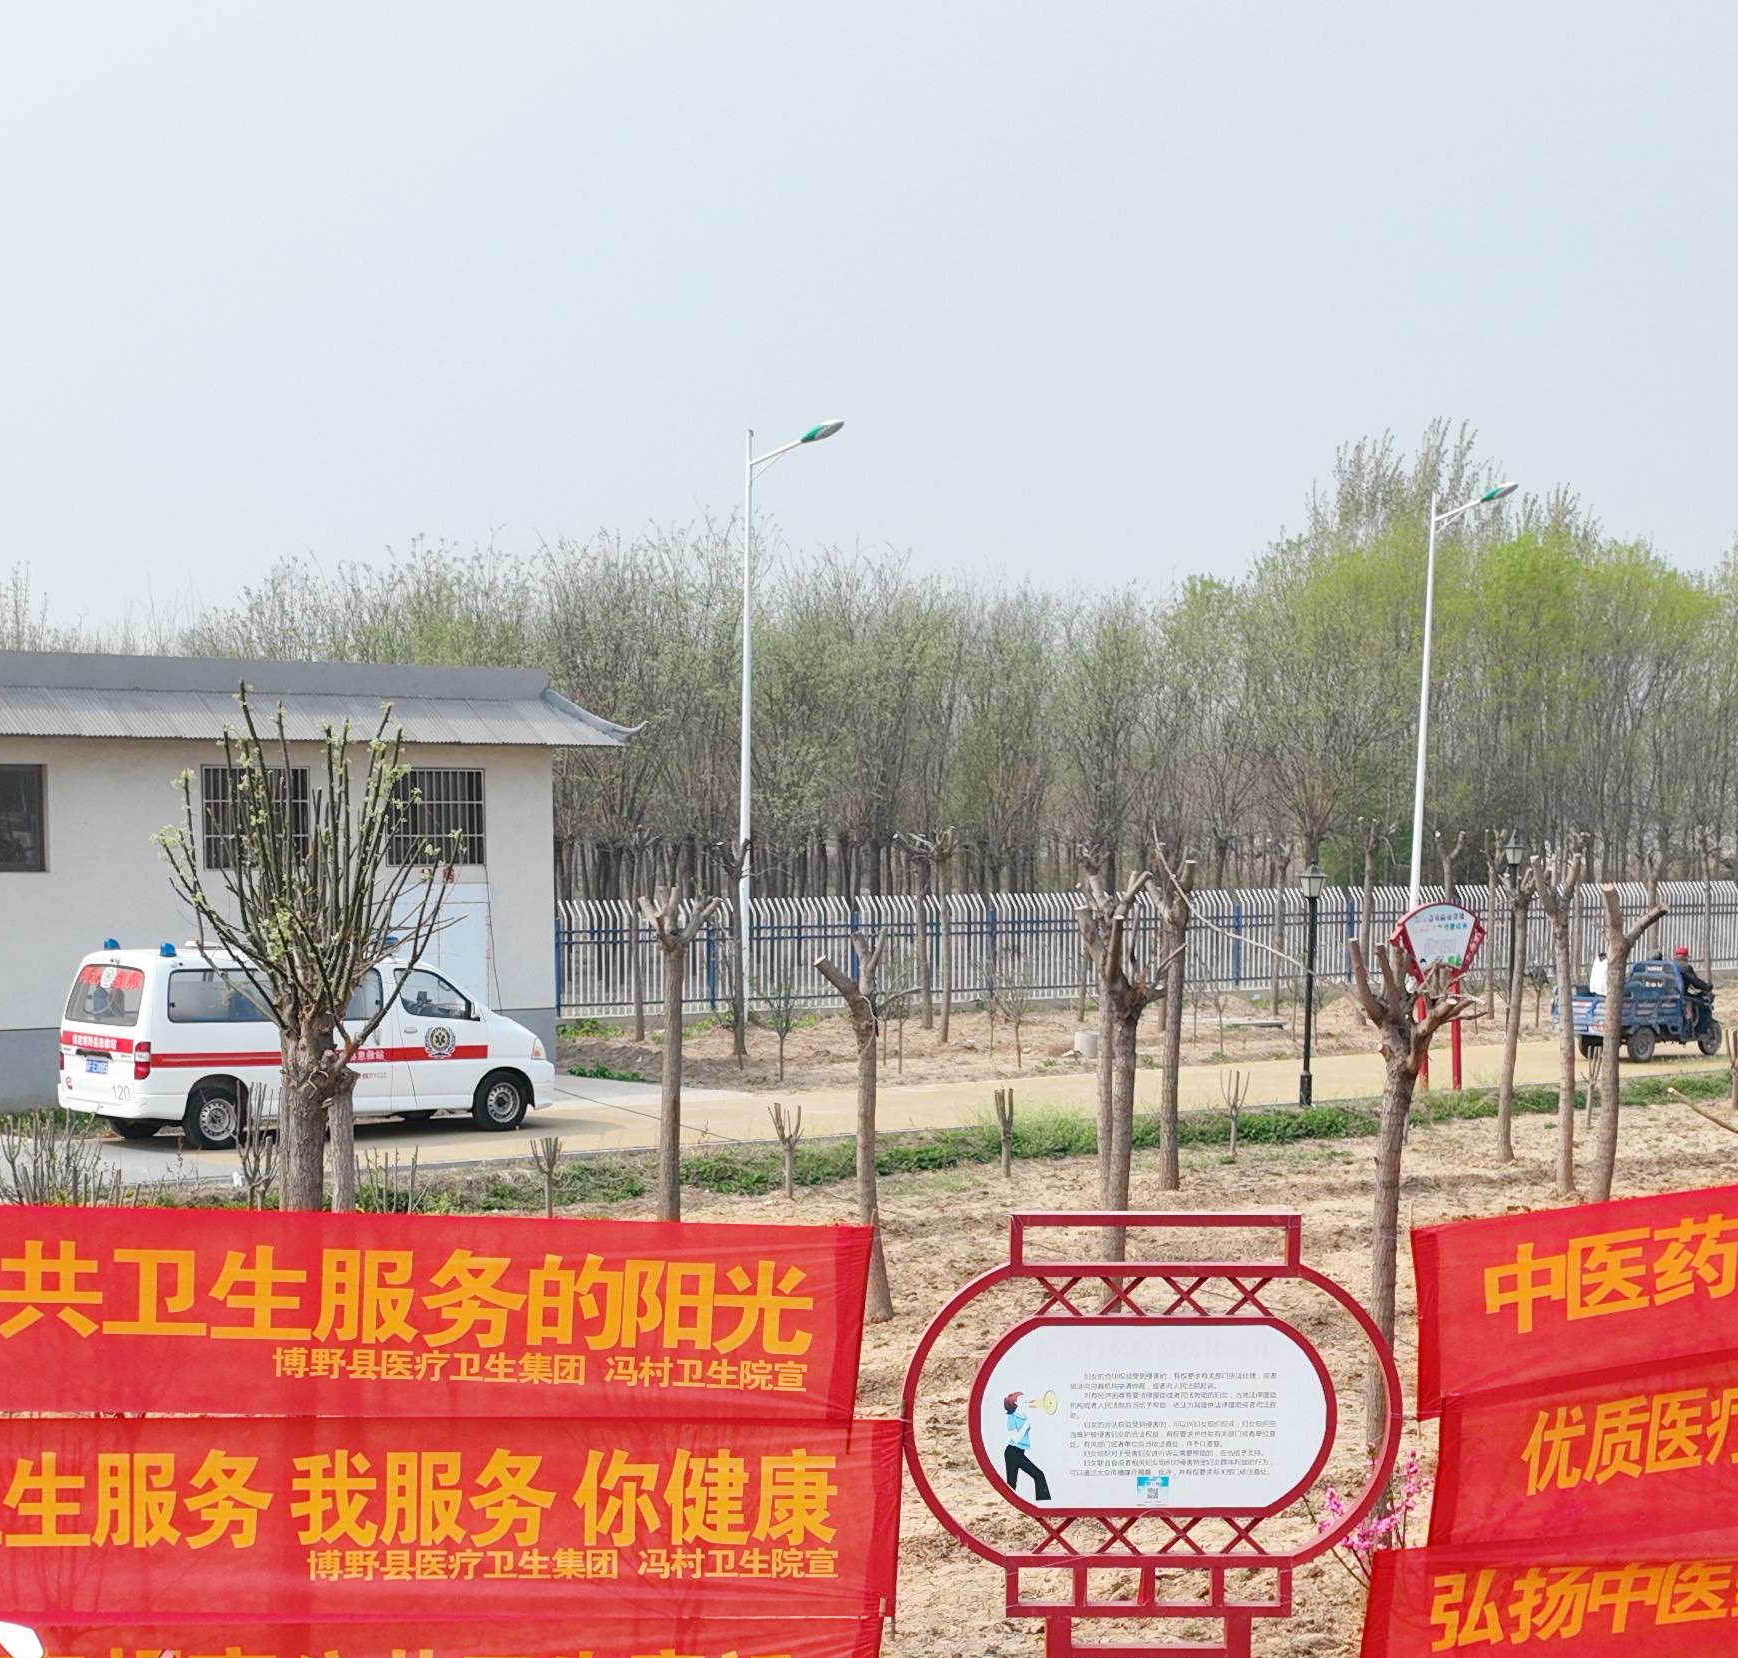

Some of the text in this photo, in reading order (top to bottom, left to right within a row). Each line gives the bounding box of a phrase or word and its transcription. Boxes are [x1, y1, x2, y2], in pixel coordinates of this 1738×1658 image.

[112, 1085, 131, 1101] 120
[272, 1346, 808, 1393] 博野县医疗卫生集团 冯村卫生院宣
[290, 1448, 556, 1548] 我服务
[572, 1448, 839, 1548] 你健康
[307, 1548, 839, 1582] 博野县医疗卫生集团 冯村卫生院宣
